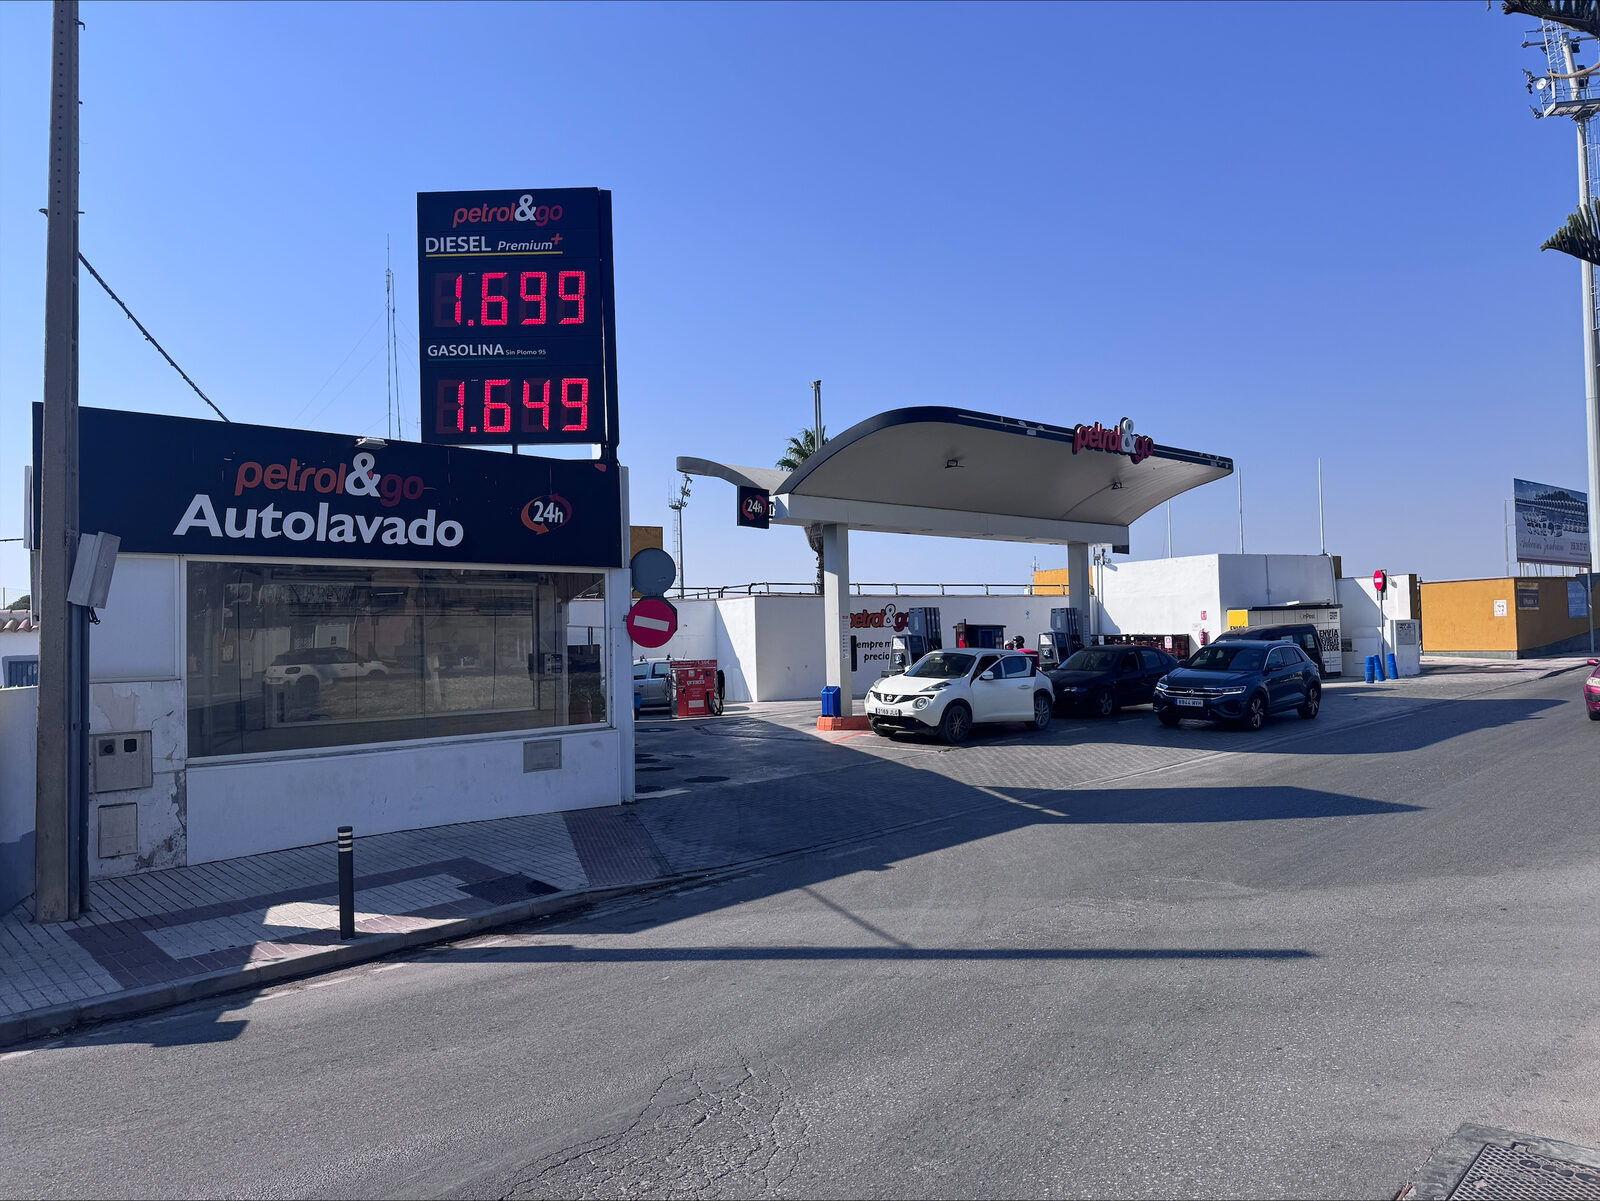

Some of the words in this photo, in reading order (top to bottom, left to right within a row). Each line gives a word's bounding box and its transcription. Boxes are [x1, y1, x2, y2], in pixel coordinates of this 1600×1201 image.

[452, 194, 563, 228] petrol&go
[425, 236, 492, 253] DIESEL
[453, 270, 586, 327] 1.699
[427, 343, 505, 358] GASOLINA
[505, 348, 516, 356] Sin
[516, 348, 538, 357] Plomo
[457, 378, 589, 433] 1.649
[1073, 417, 1154, 464] petrol&go
[234, 451, 425, 508] petrol&go
[173, 494, 465, 549] Autolavado
[532, 500, 564, 524] 24h
[747, 499, 763, 513] 24h
